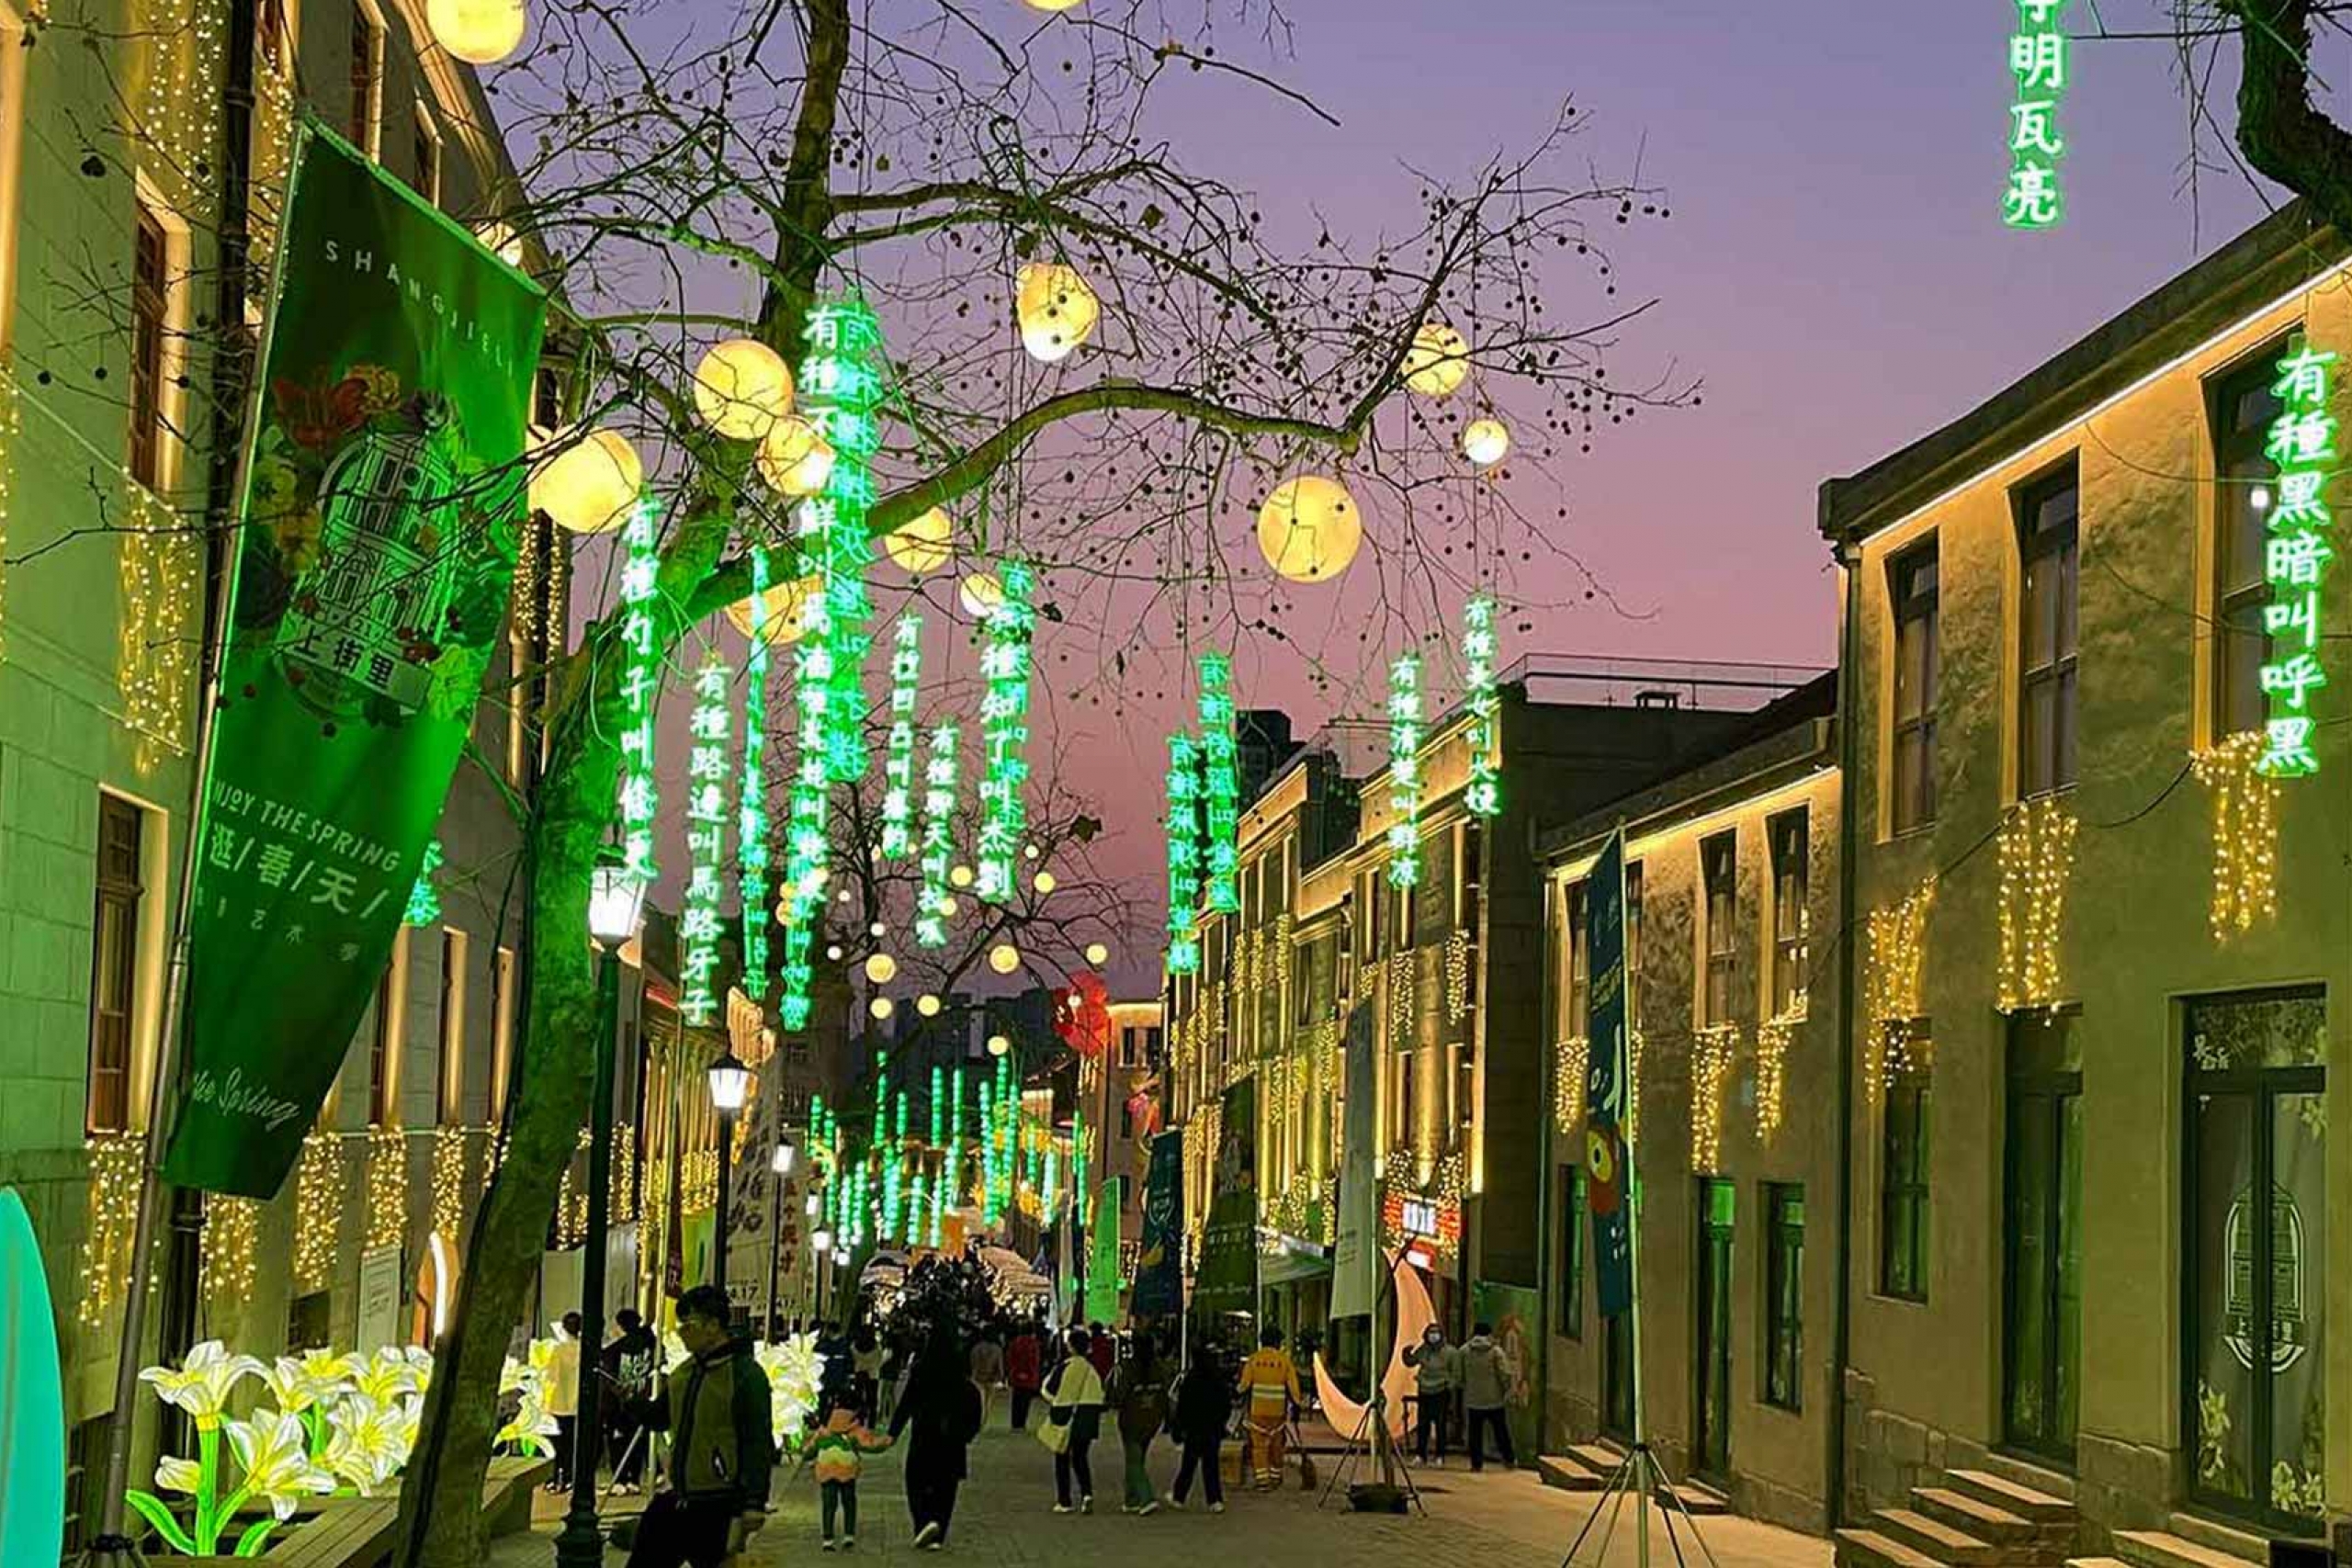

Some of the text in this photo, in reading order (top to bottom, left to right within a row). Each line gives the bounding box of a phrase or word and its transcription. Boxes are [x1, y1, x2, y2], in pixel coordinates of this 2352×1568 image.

[293, 626, 394, 690] 上街里
[2258, 347, 2336, 773] 有種黑暗叫呼黑
[261, 800, 308, 834] THE
[307, 818, 401, 873] SPRING
[679, 665, 733, 1026] 有種路邊叫馬路牙子
